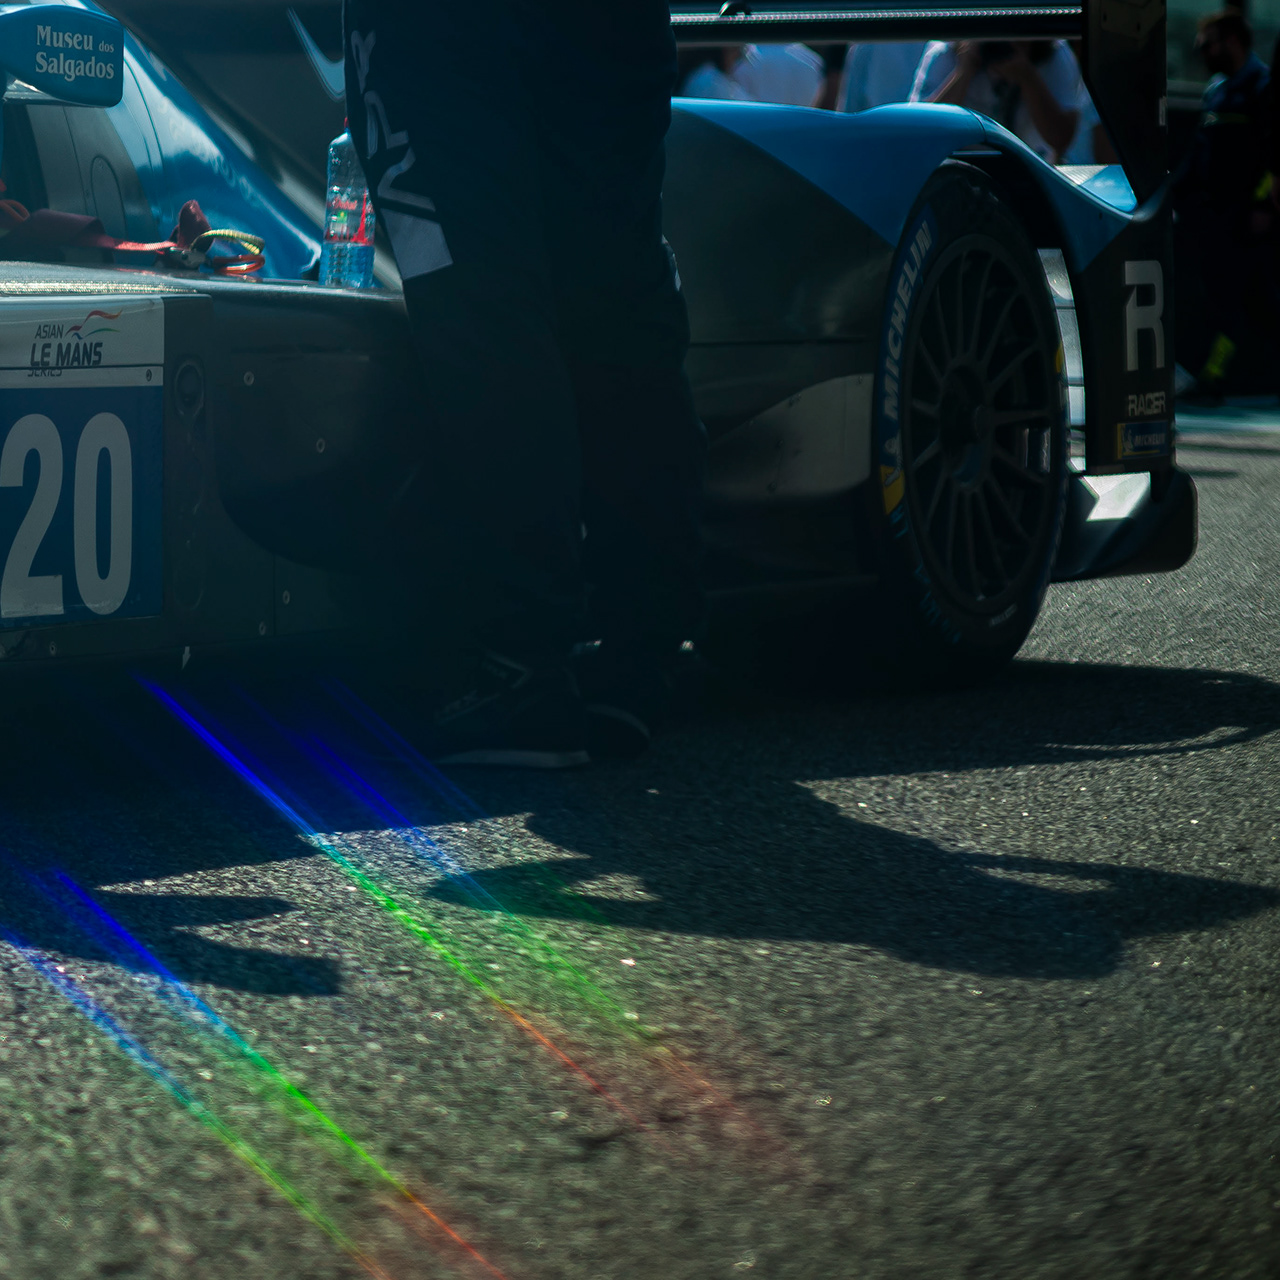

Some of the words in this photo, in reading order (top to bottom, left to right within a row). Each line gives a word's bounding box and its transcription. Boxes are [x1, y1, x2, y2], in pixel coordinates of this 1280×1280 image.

[36, 24, 94, 51] Museu
[98, 40, 115, 53] dos
[35, 51, 116, 82] Salgados
[34, 324, 65, 339] ASIAN
[884, 219, 933, 421] MICHELIN
[30, 342, 52, 367] LE
[55, 342, 103, 367] MANS
[1133, 432, 1167, 448] MICHELIN
